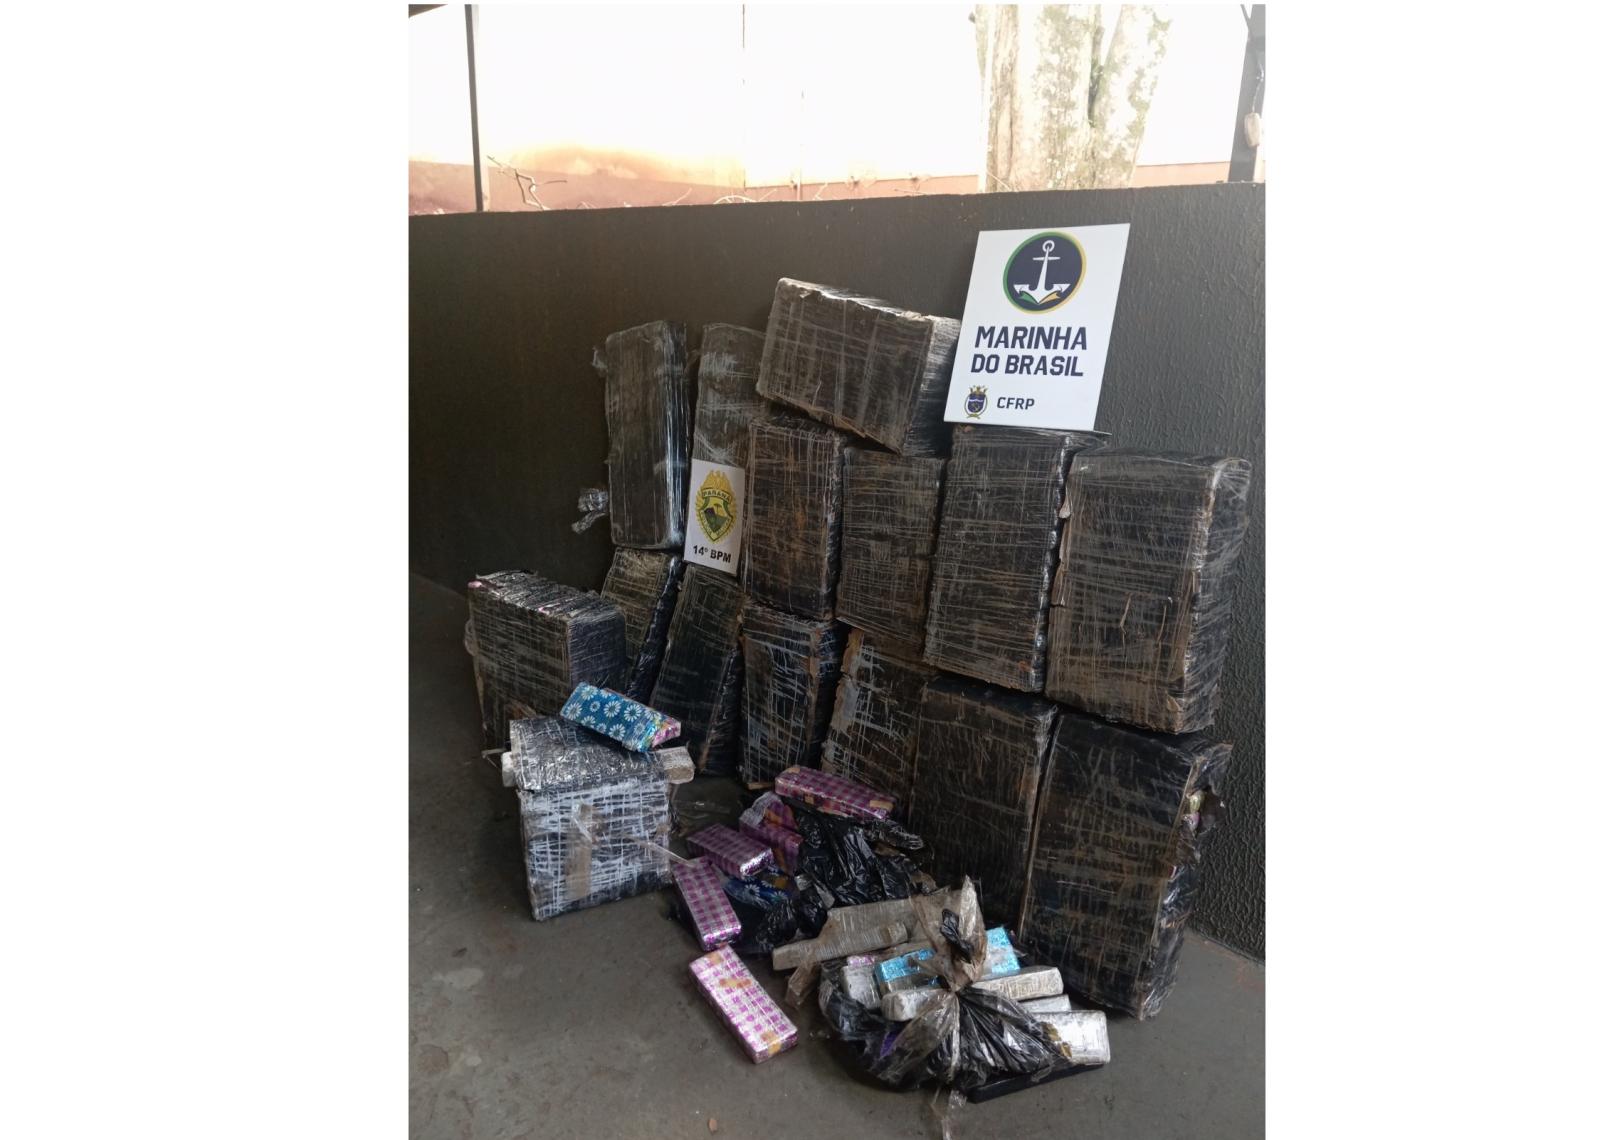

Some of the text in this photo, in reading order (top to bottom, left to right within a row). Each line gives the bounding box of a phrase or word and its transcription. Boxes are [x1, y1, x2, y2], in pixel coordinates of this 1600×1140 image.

[974, 326, 1087, 350] MARINHA
[970, 354, 1084, 377] DO BRASIL
[996, 397, 1035, 410] CFRP
[710, 549, 732, 563] BPM
